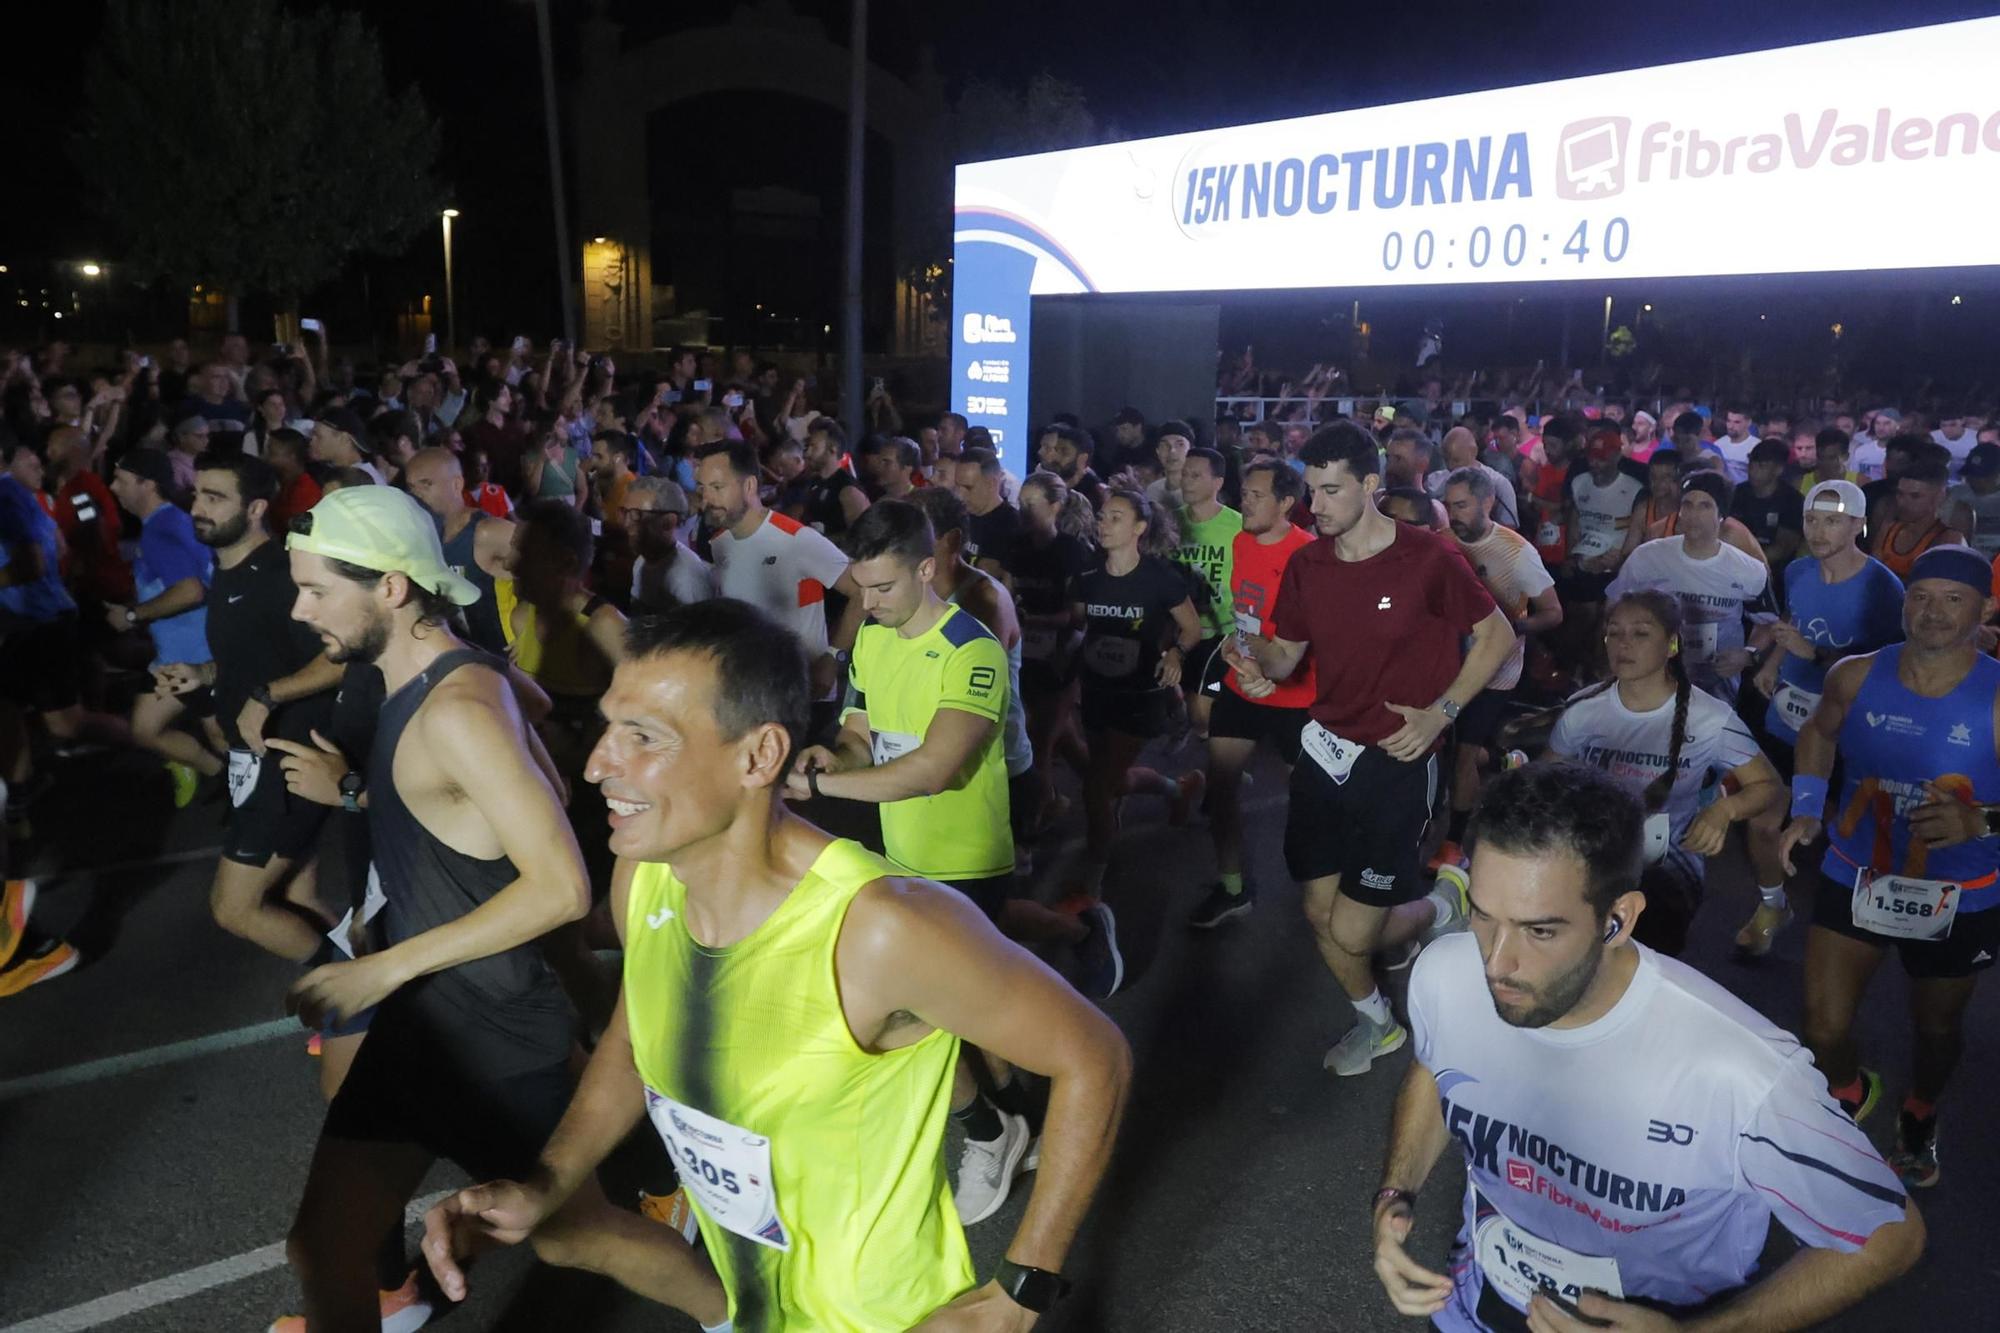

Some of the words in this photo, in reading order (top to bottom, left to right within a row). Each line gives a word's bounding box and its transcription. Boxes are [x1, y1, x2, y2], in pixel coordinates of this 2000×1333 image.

[1183, 164, 1238, 224] 15K
[1241, 131, 1533, 219] NOCTURNA
[1382, 216, 1630, 271] 00:00:40
[1875, 896, 1934, 917] 1.568
[1508, 1123, 1686, 1212] NOCTURNA
